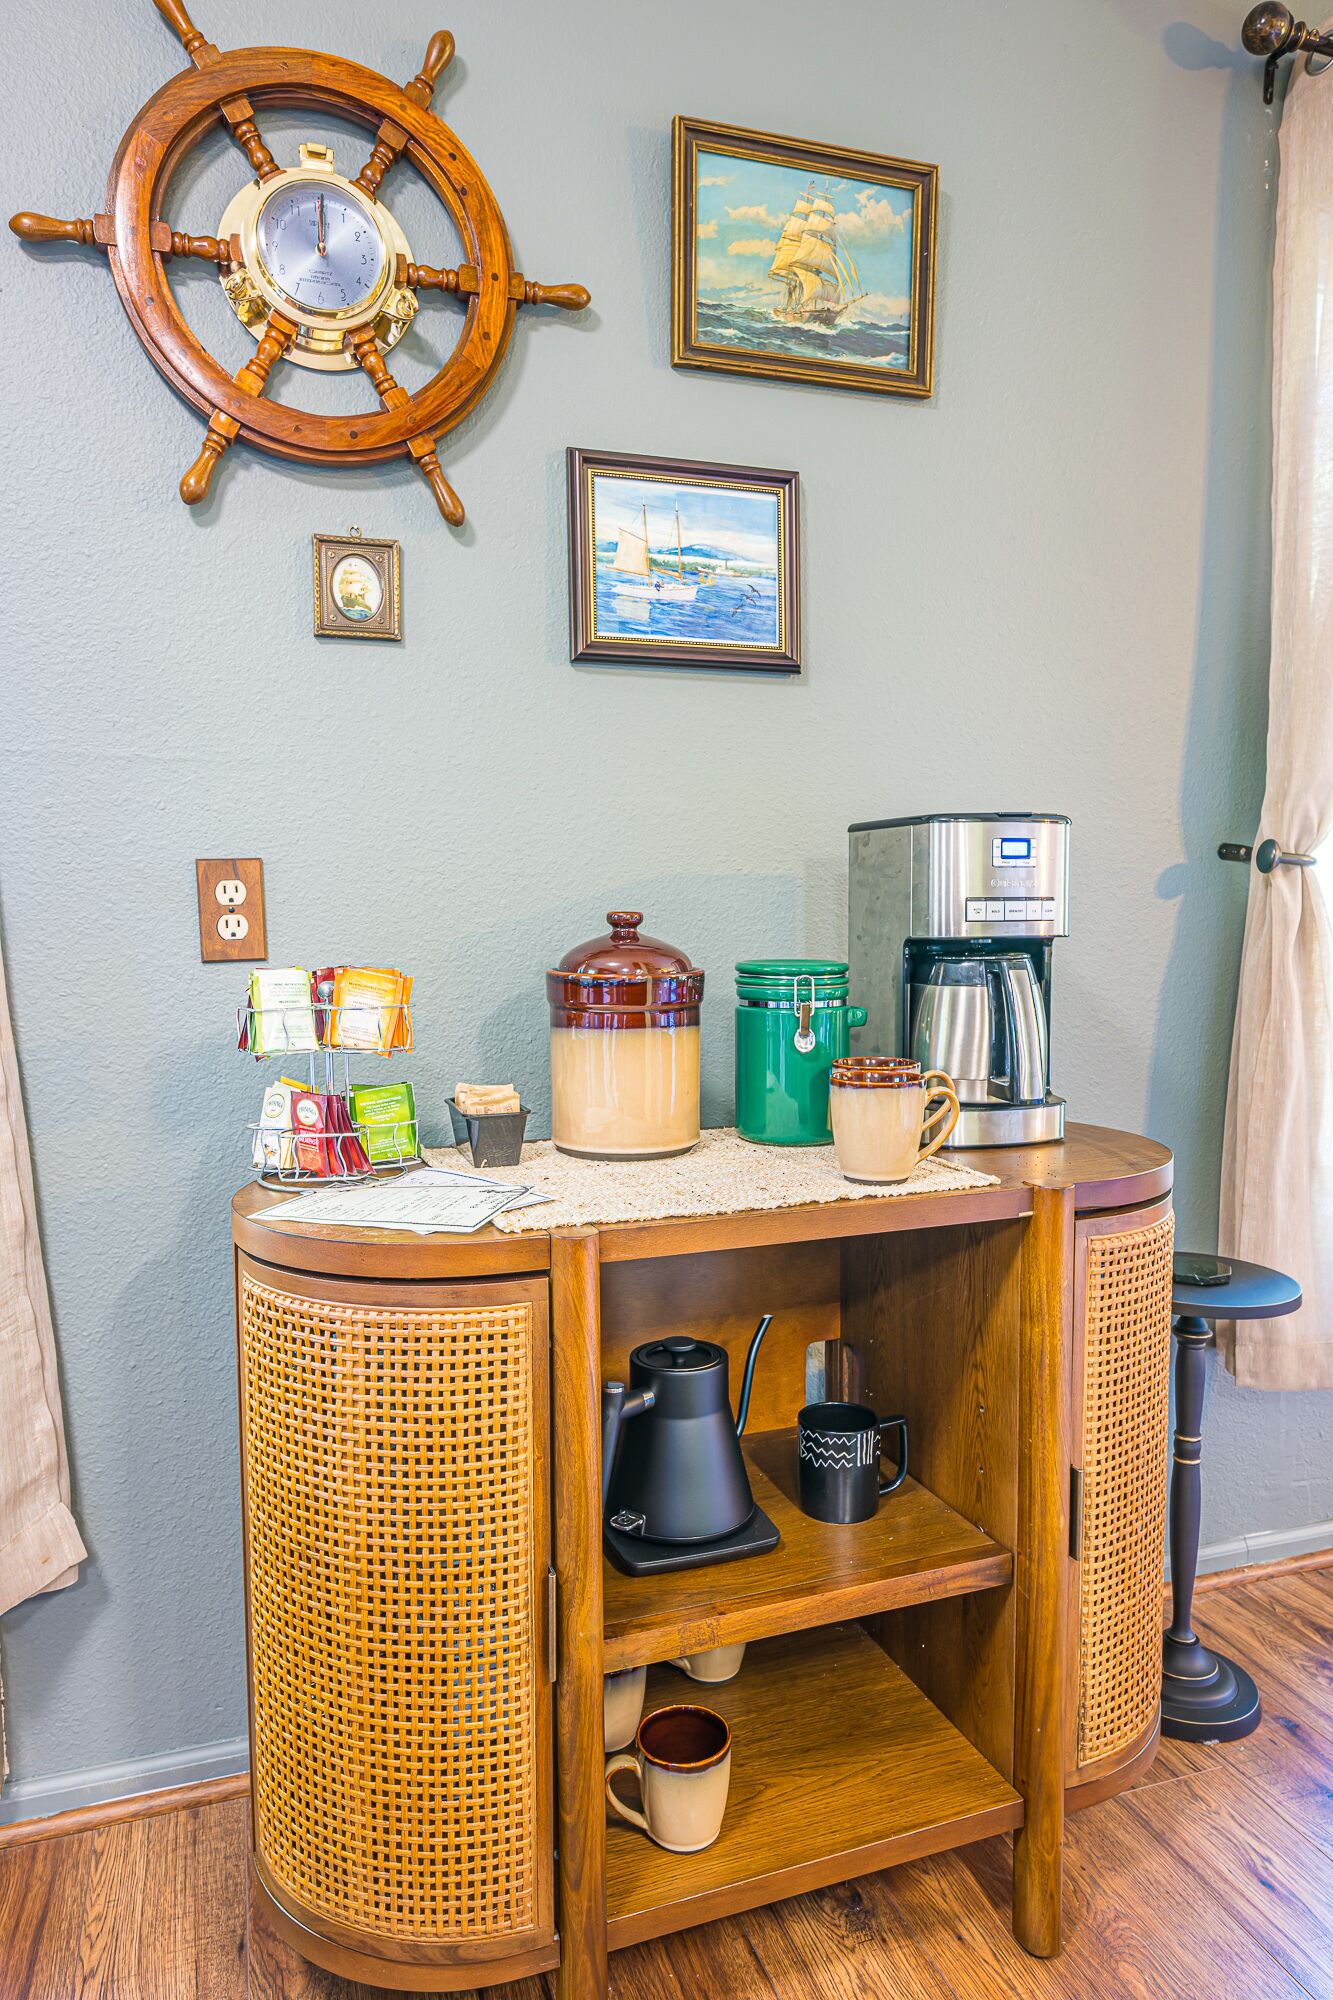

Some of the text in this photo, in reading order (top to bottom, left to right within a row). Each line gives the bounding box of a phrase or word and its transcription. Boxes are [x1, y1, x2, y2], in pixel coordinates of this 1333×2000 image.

[290, 204, 300, 217] 11
[341, 213, 345, 223] 1
[275, 218, 287, 231] 10
[354, 231, 361, 242] 2
[271, 240, 279, 251] 9
[360, 254, 367, 265] 3
[279, 264, 286, 275] 8
[355, 276, 361, 286] 4
[294, 282, 301, 296] 7
[317, 291, 325, 304] 6
[340, 288, 347, 302] 5
